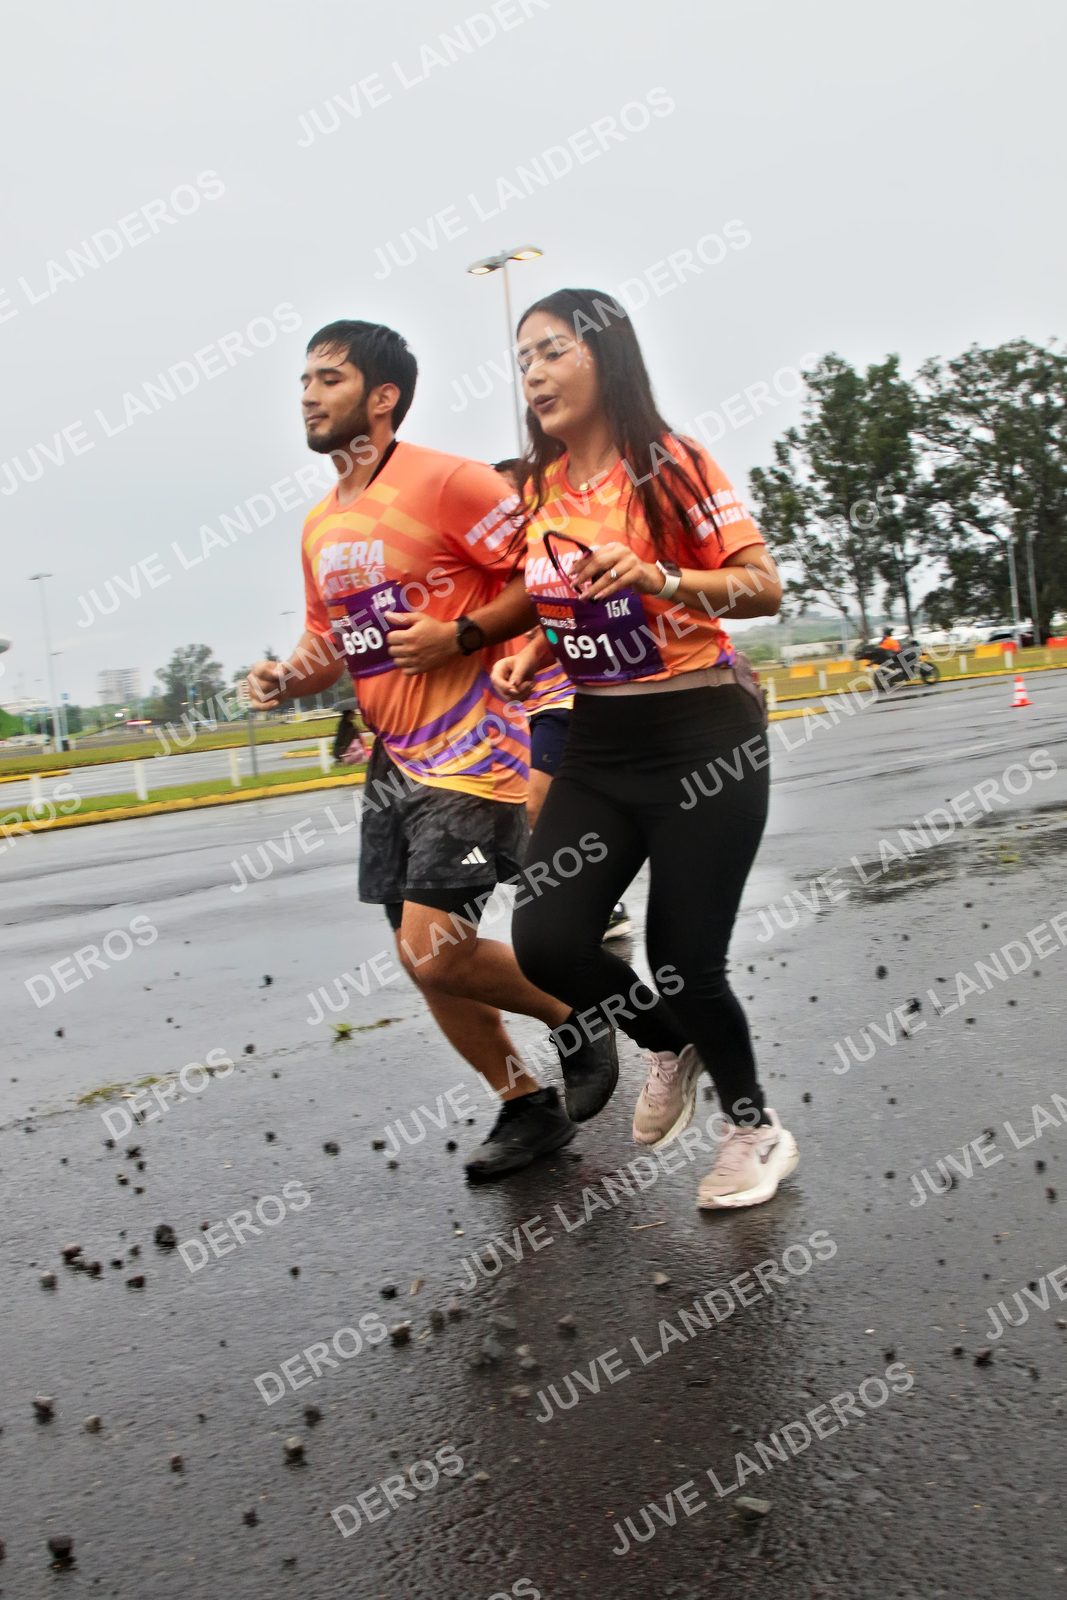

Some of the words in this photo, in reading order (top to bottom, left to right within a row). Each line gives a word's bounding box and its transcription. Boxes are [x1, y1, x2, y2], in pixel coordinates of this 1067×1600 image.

[605, 598, 631, 619] 15K
[342, 627, 384, 656] 690
[563, 633, 615, 659] 691
